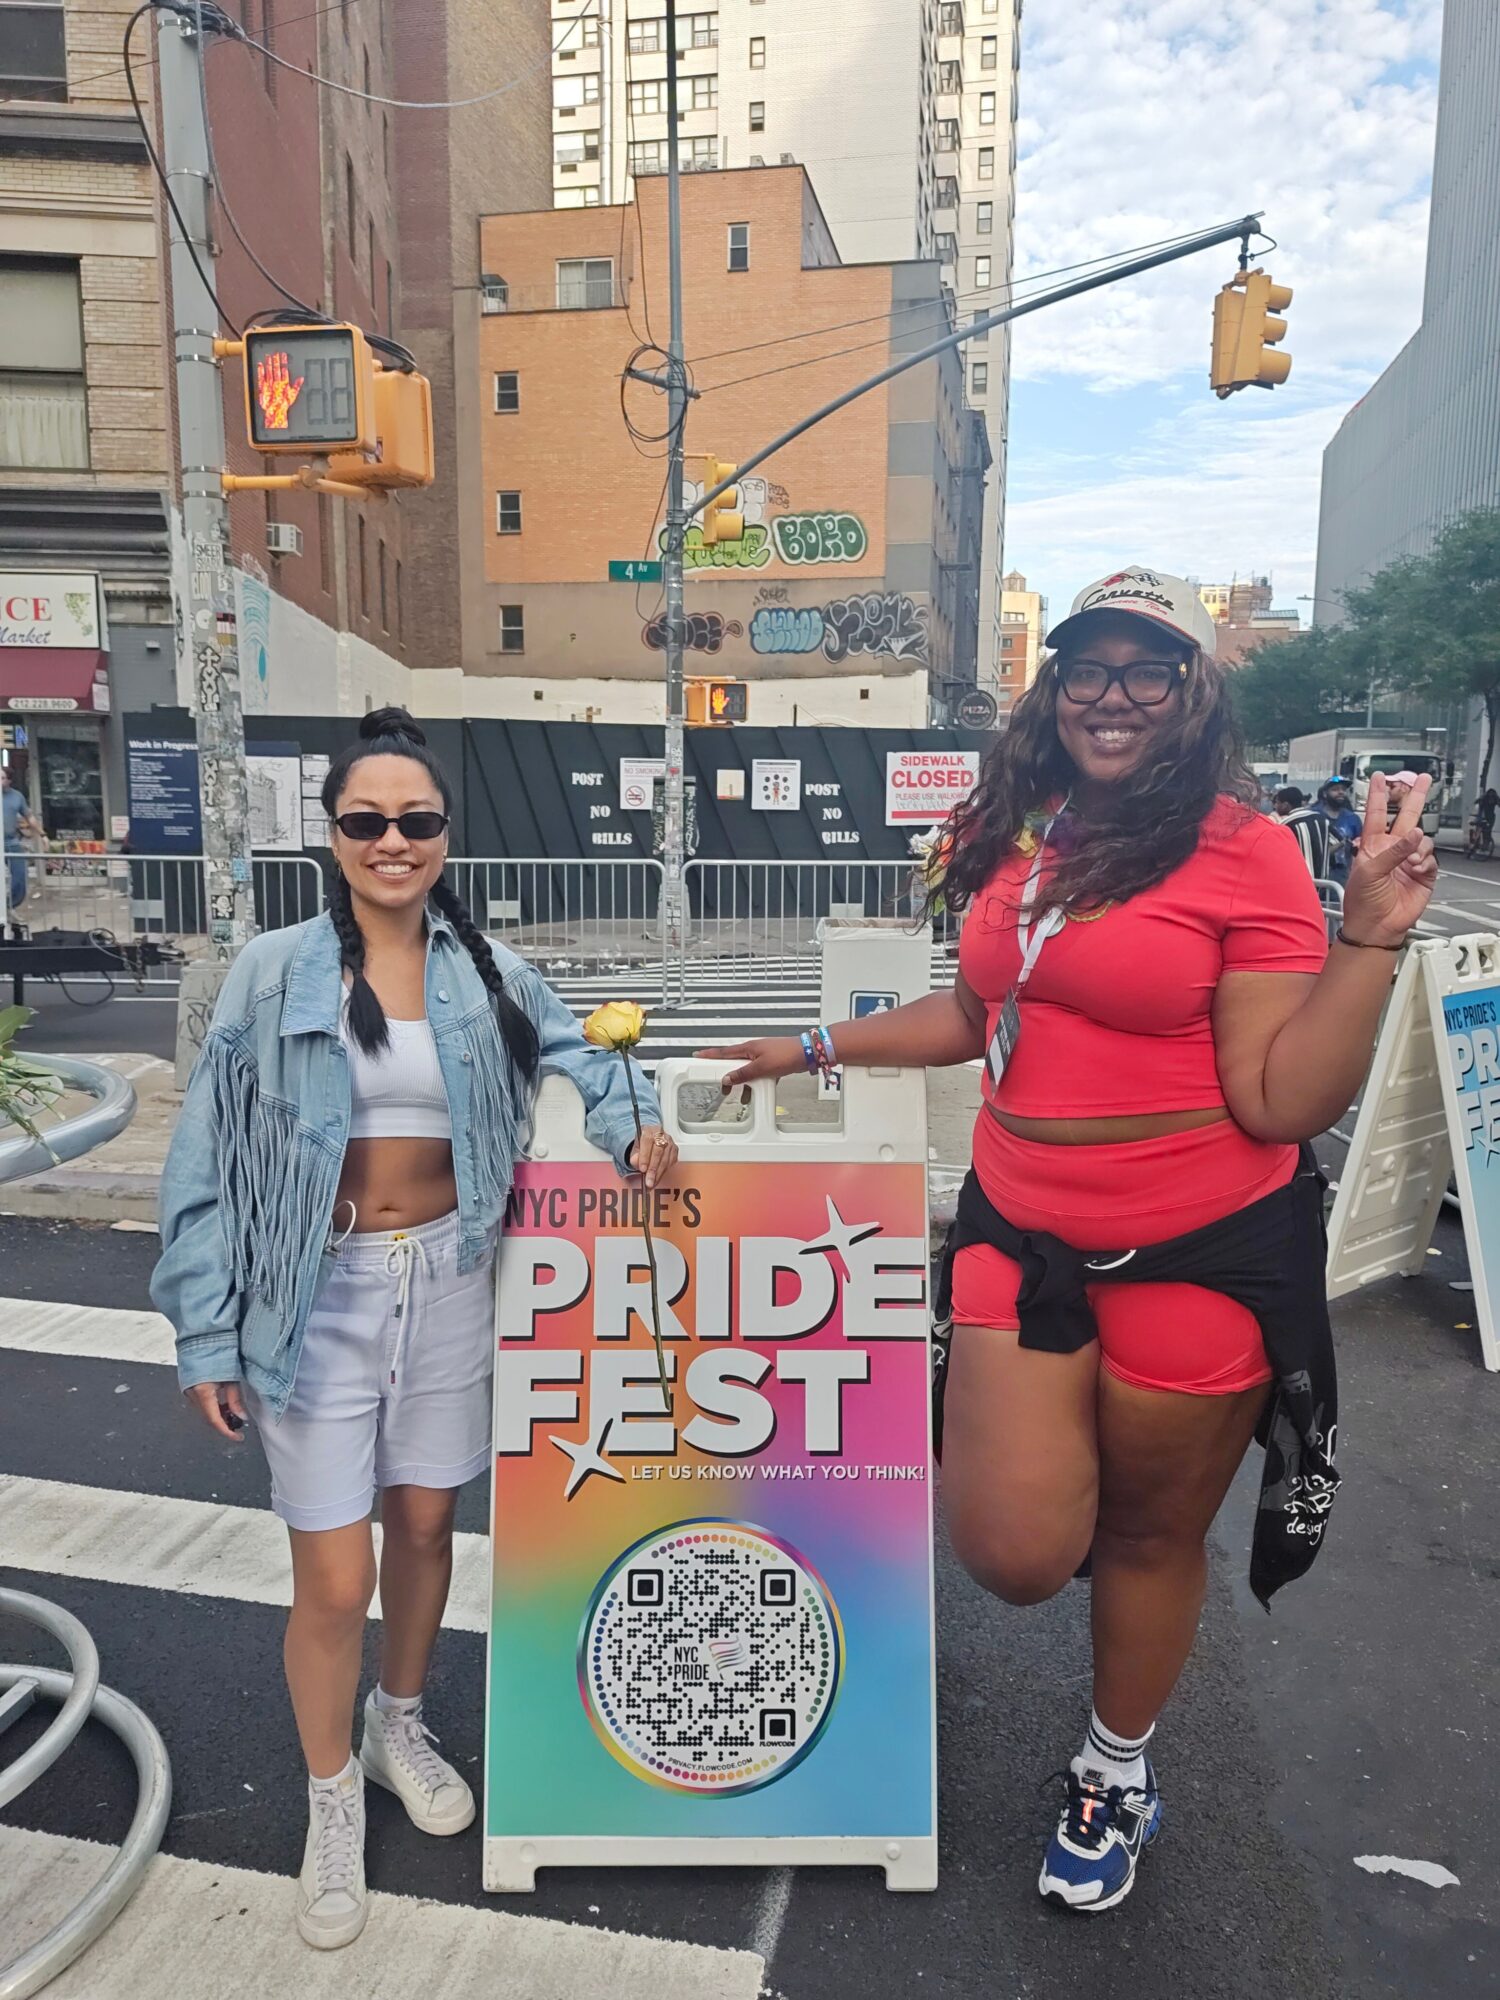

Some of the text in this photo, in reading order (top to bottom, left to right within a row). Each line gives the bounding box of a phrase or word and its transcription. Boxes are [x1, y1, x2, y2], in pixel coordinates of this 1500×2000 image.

[773, 515, 866, 564] BORO
[625, 563, 633, 579] 4
[1081, 588, 1174, 611] Corvette
[0, 597, 52, 621] CE
[962, 705, 991, 715] PIZZA
[129, 740, 199, 751] Work in Progress
[900, 755, 965, 766] SIDEWALK
[572, 772, 604, 786] POST
[891, 770, 974, 788] CLOSED
[805, 784, 840, 796] POST
[896, 792, 920, 800] PLEASE
[921, 792, 936, 800] USE
[590, 805, 611, 819] NO
[822, 807, 842, 820] NO
[592, 832, 632, 845] BILLS
[822, 831, 859, 844] BILLS
[1444, 1008, 1463, 1032] NYC
[1447, 1026, 1500, 1091] PR
[504, 1188, 567, 1228] NYC
[499, 1236, 927, 1341] PRIDE
[496, 1347, 871, 1458] FEST
[631, 1464, 925, 1481] LET US KNOW WHAT YOU THINK!
[674, 1647, 698, 1663] NYC
[674, 1664, 710, 1680] PRIDE
[668, 1757, 753, 1771] PRIVACY.FLOWCODE.COM
[1085, 1768, 1104, 1780] NIKE
